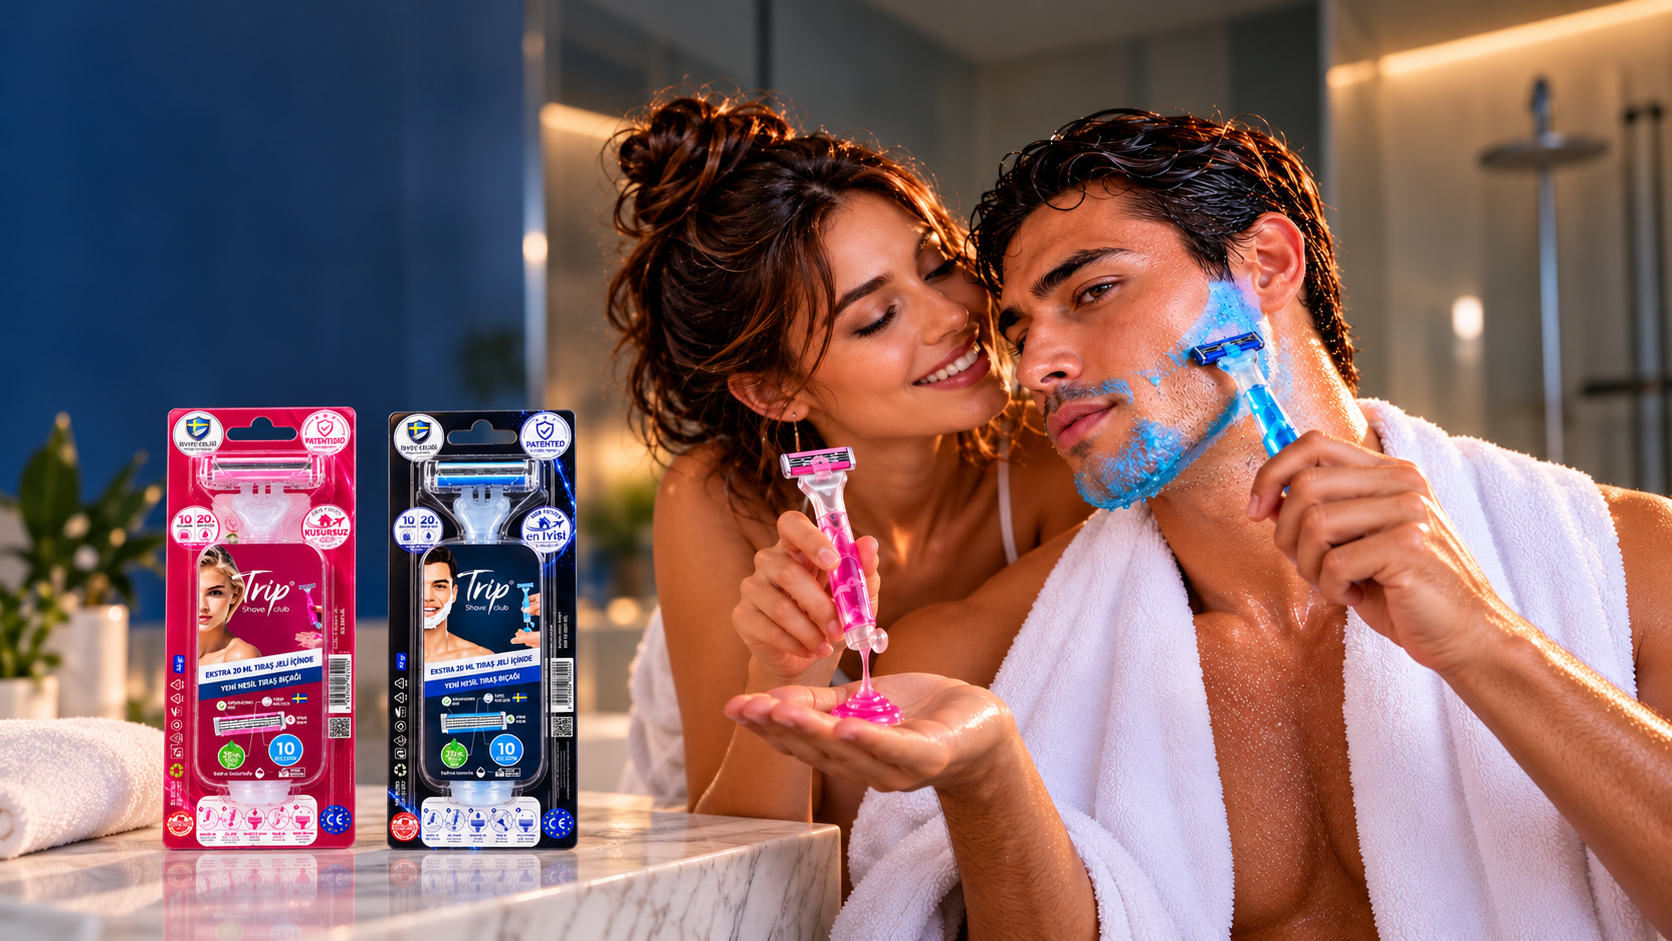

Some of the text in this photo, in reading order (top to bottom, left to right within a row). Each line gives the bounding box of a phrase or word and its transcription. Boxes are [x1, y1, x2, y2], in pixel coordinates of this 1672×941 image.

[526, 440, 565, 448] PATENTED
[178, 514, 192, 524] 10
[402, 515, 415, 525] 10
[526, 533, 540, 541] en
[231, 570, 290, 617] Trip
[456, 569, 510, 615] Trip
[273, 605, 290, 613] club
[205, 668, 232, 679] EKSTRA
[233, 666, 242, 675] 20
[430, 666, 455, 676] EKSTRA
[276, 741, 295, 756] 10
[497, 741, 516, 756] 10
[326, 813, 343, 826] CE
[549, 817, 565, 830] CE
